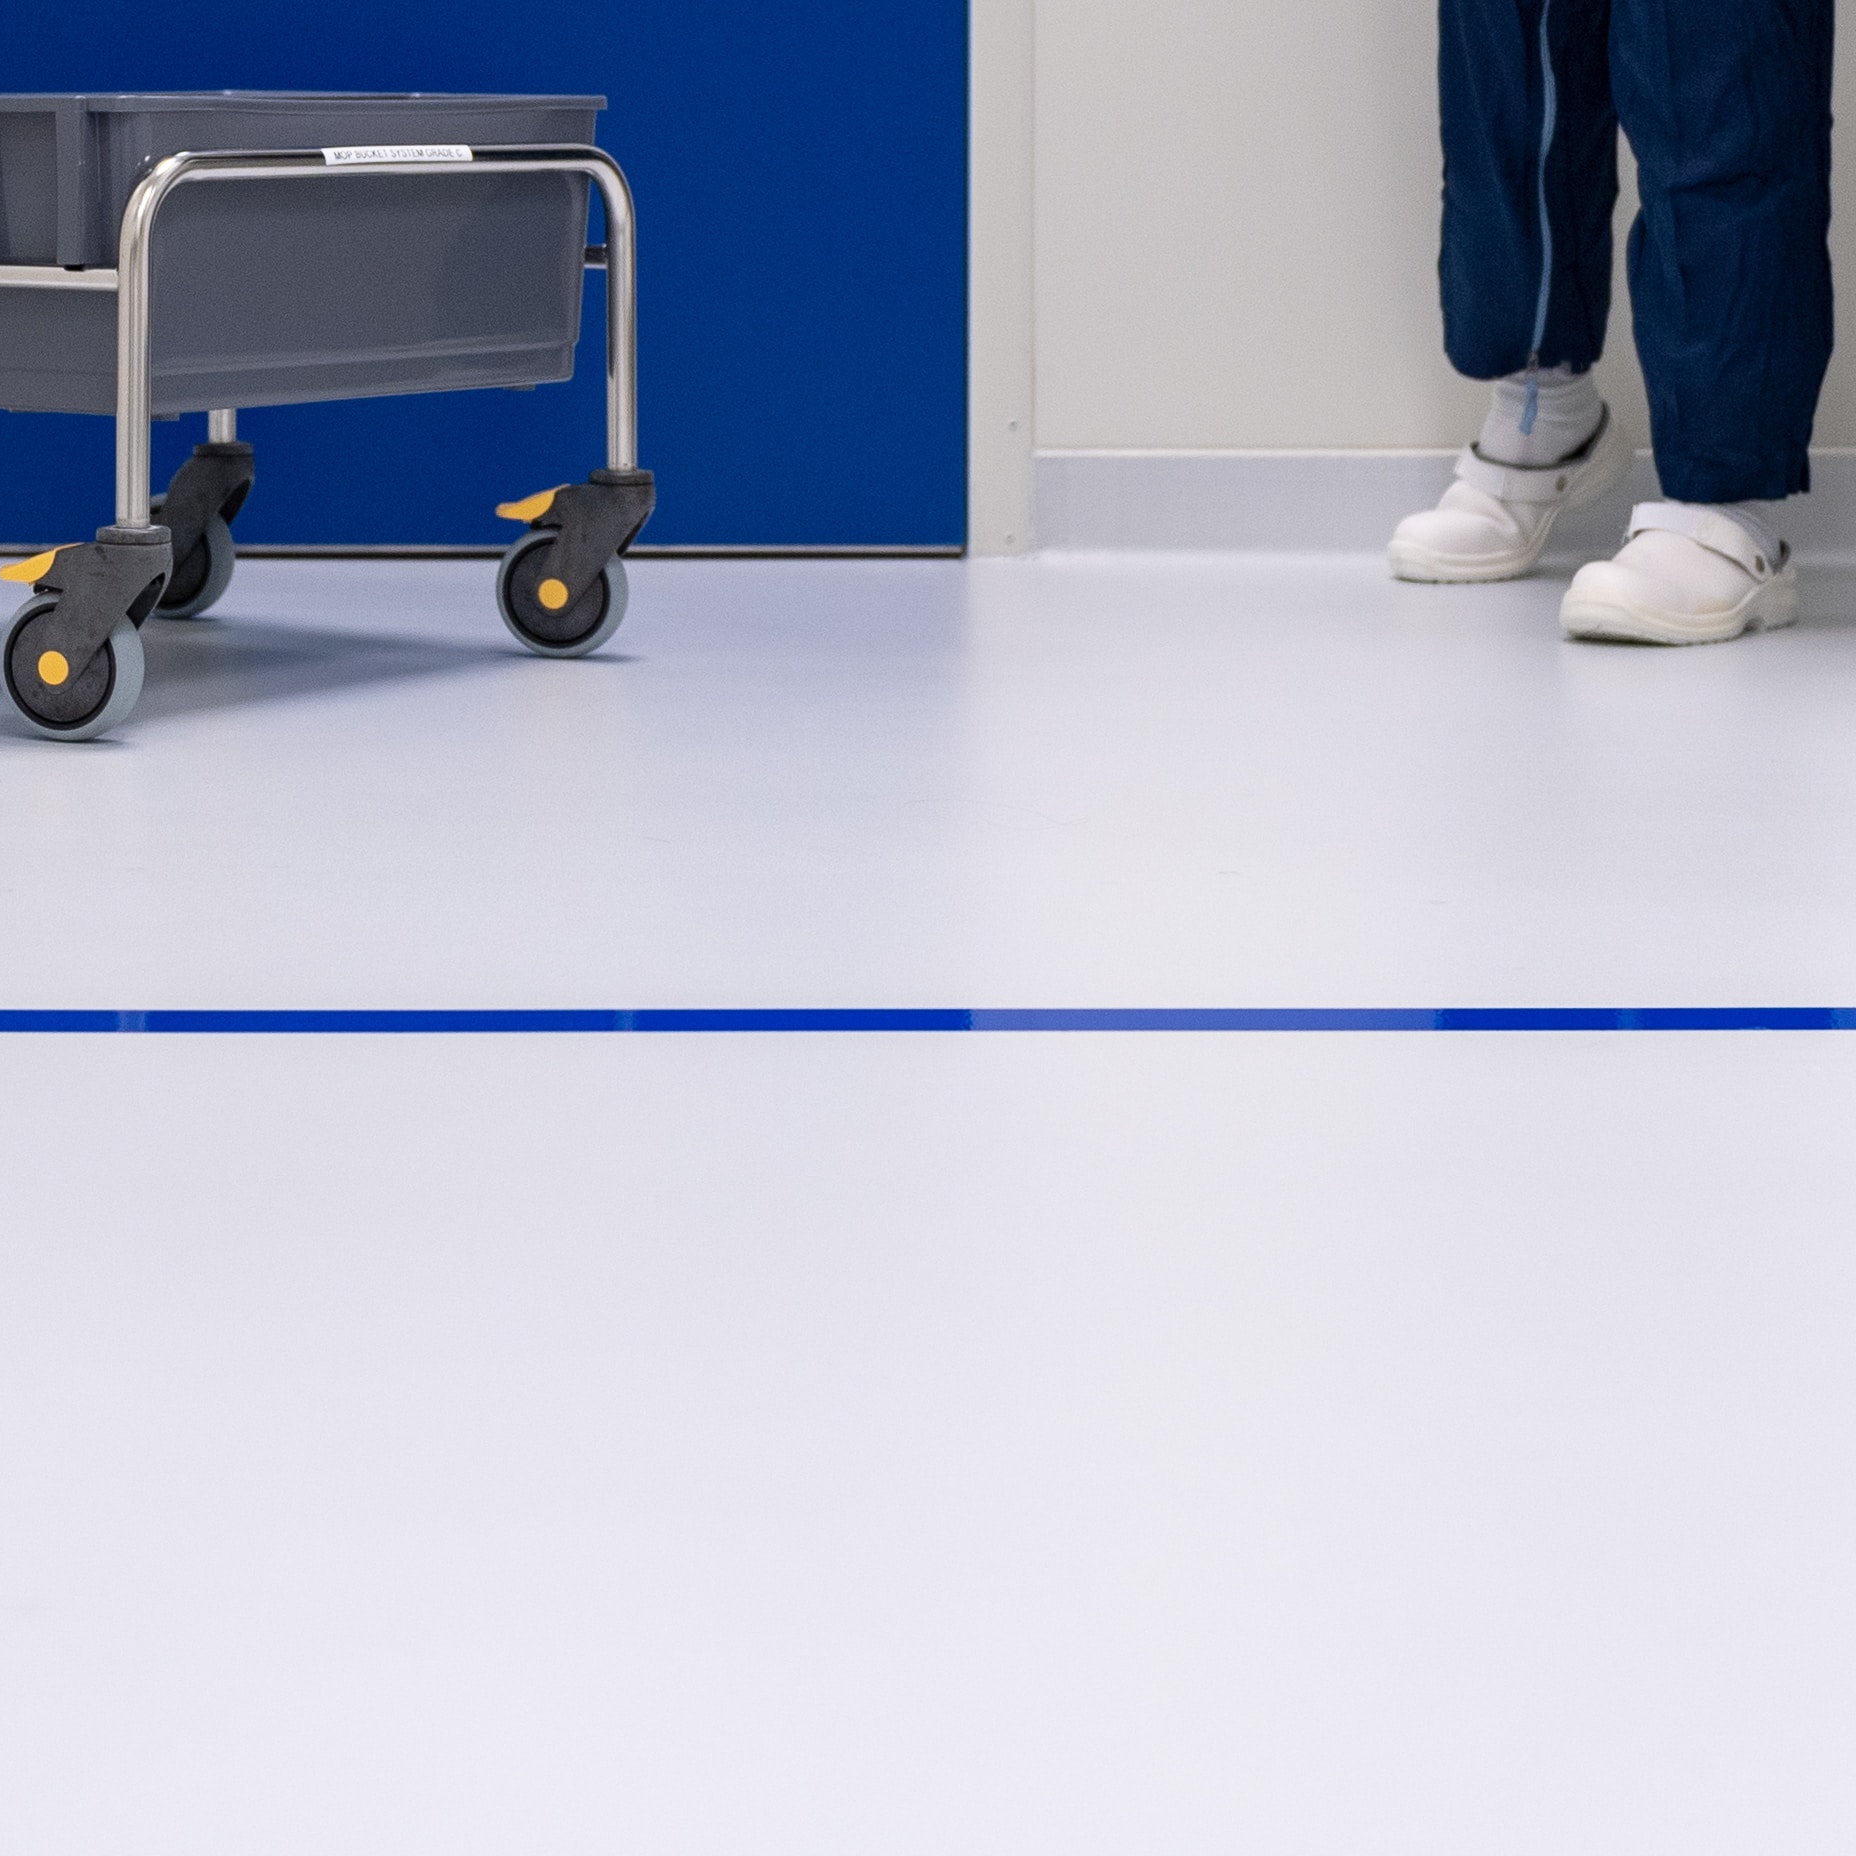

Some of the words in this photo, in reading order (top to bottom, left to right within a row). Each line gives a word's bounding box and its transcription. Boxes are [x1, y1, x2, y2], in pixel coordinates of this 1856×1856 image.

[333, 150, 353, 160] MOP
[354, 149, 388, 159] BUCKET
[390, 148, 424, 158] SYSTEM
[424, 148, 454, 158] GRADE
